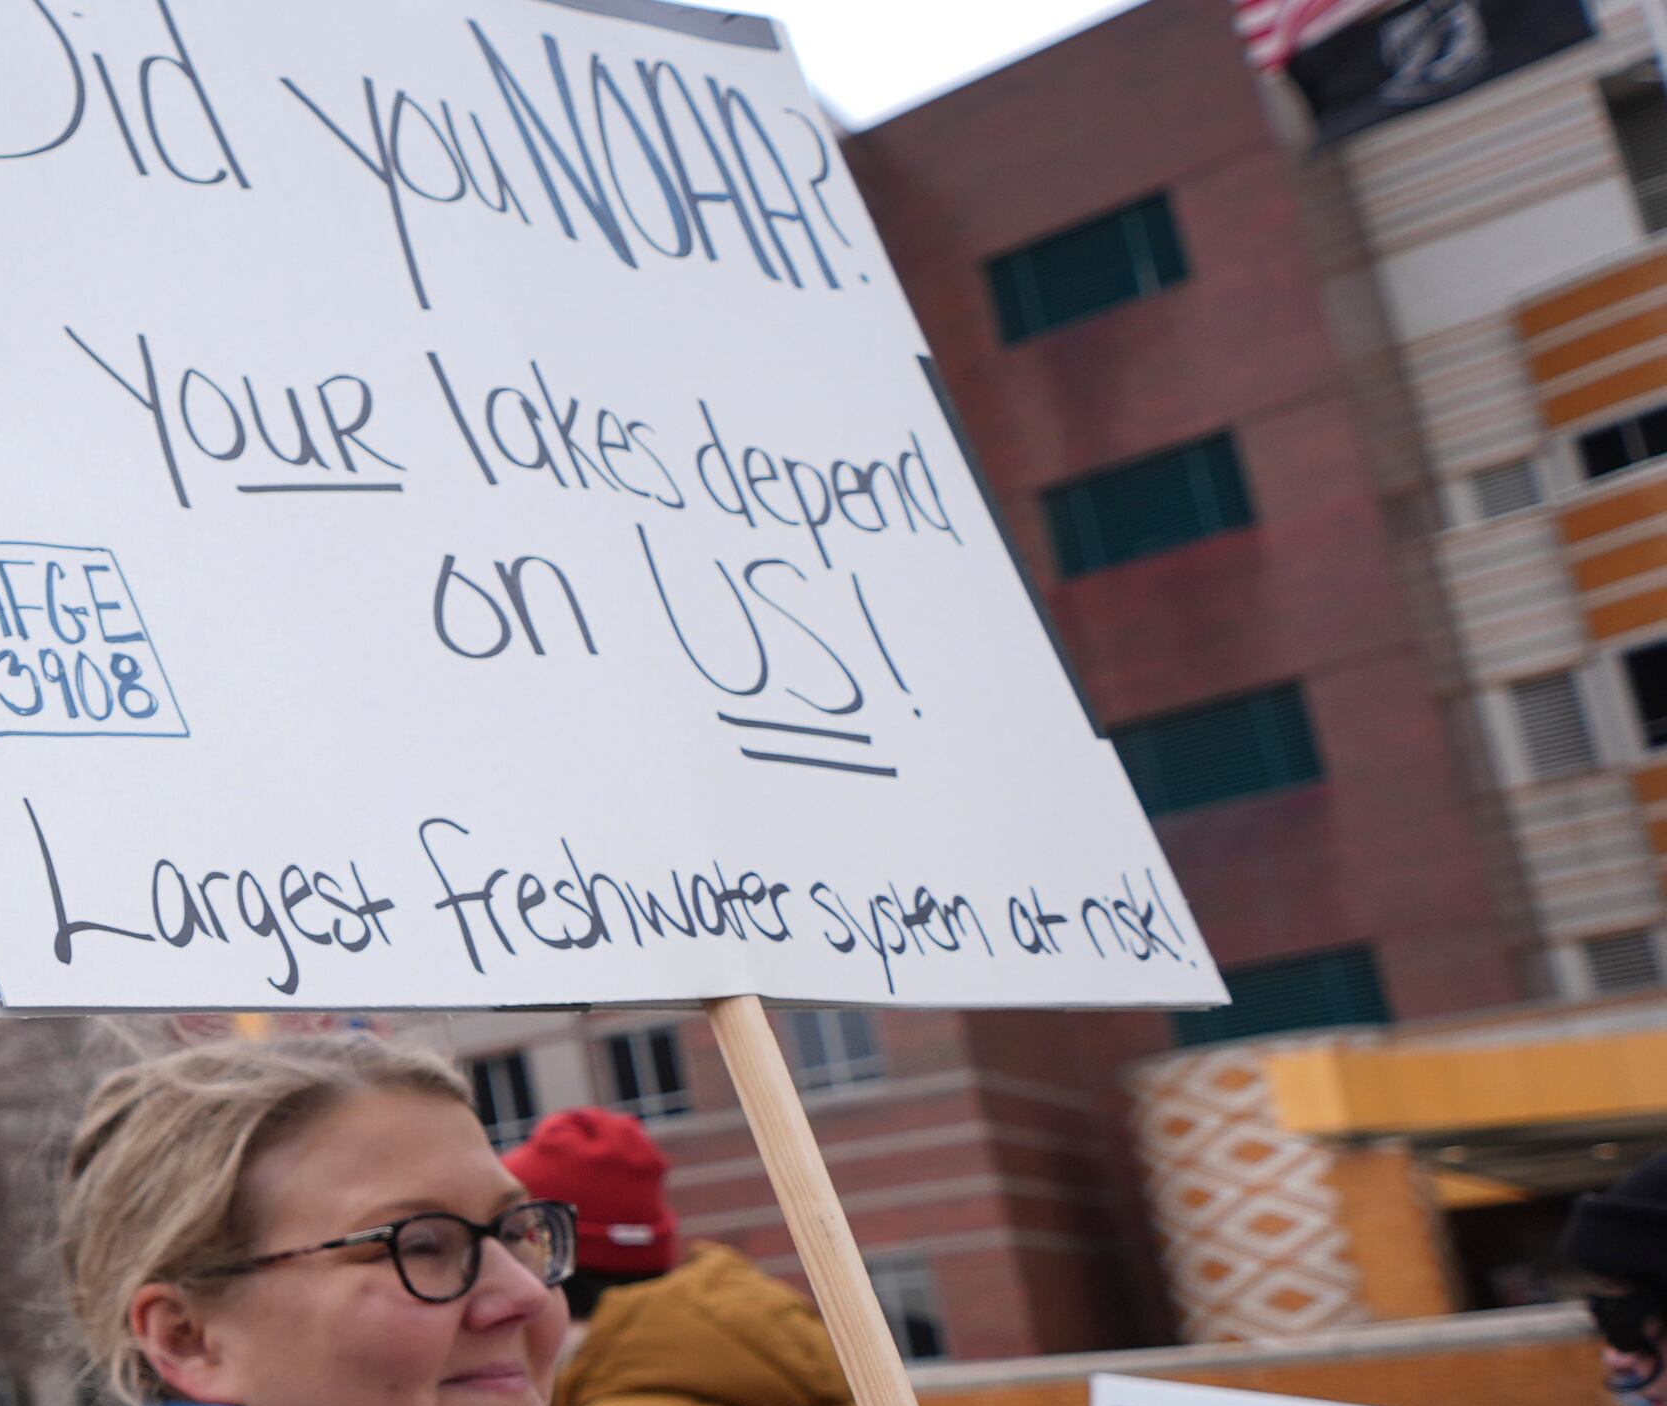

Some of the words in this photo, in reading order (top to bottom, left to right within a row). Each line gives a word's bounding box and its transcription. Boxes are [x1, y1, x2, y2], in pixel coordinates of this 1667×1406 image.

[279, 76, 530, 310] you
[427, 351, 685, 510] lakes
[696, 398, 964, 569] depend
[433, 555, 598, 658] on
[635, 522, 921, 717] US!
[22, 797, 395, 995] Largest
[419, 818, 793, 975] freshwater
[809, 880, 994, 996] system
[1008, 885, 1068, 955] at
[1080, 867, 1198, 969] risk!
